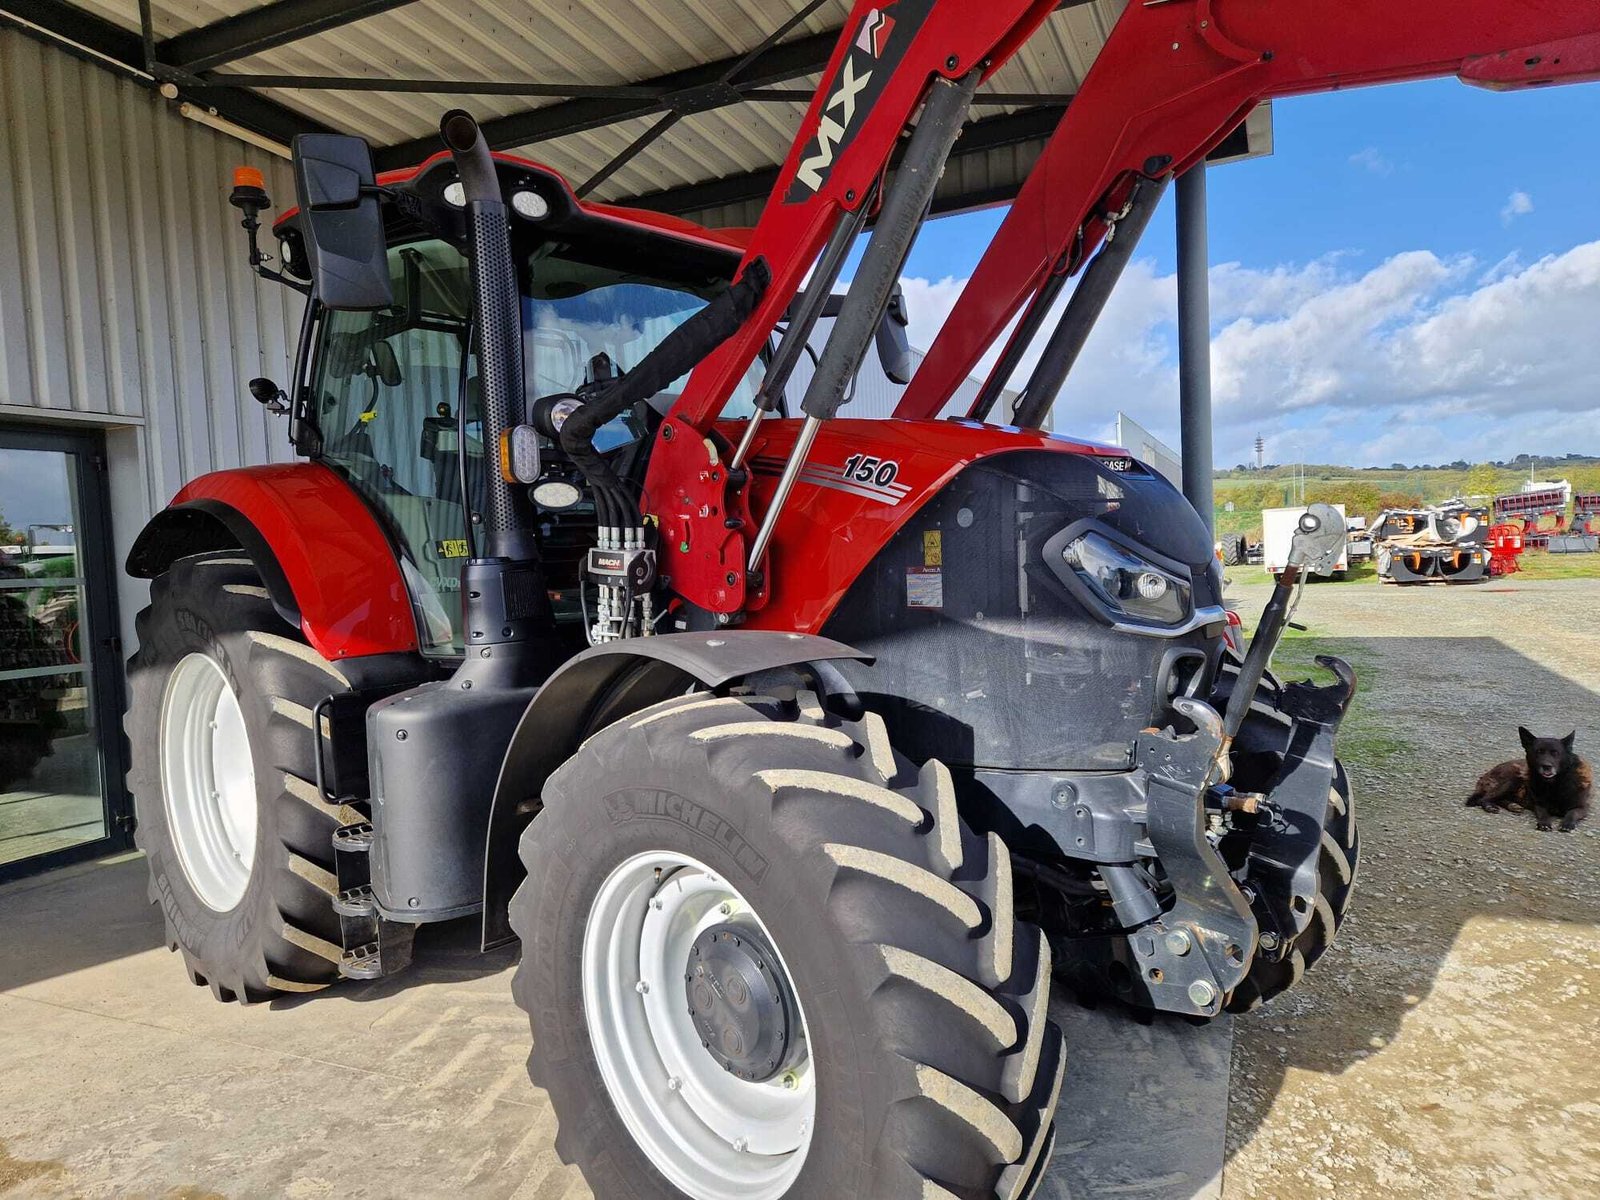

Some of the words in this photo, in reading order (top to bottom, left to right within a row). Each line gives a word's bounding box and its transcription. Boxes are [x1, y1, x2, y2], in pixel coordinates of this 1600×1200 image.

[797, 54, 873, 192] MX
[843, 454, 898, 487] 150
[634, 792, 768, 875] MICHELIN
